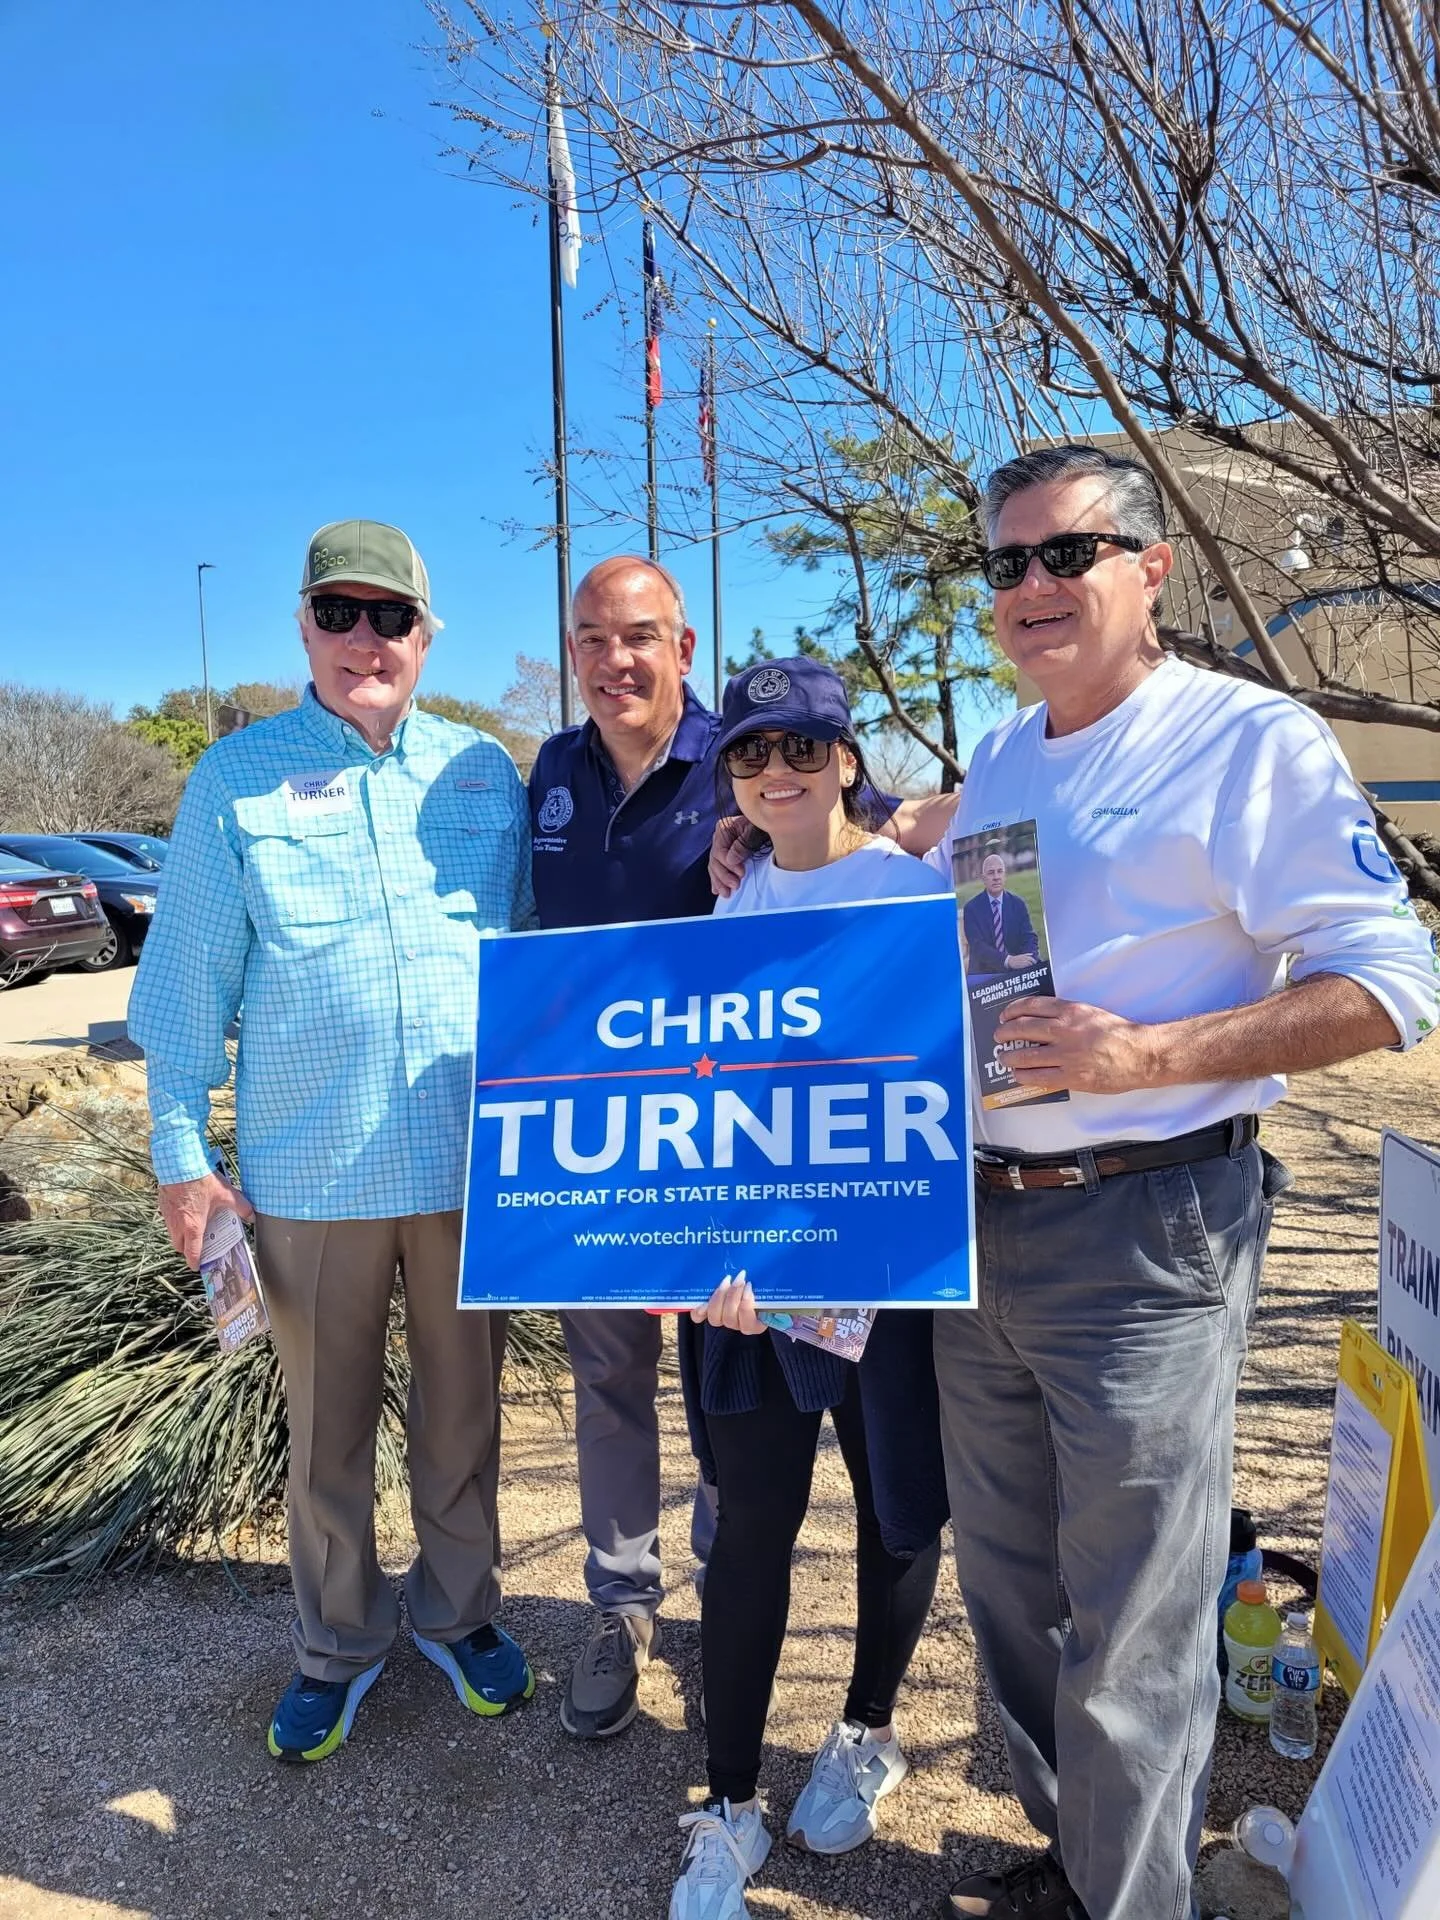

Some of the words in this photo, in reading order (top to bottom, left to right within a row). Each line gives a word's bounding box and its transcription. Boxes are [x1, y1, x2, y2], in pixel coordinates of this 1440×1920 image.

[289, 786, 346, 801] TURNER
[303, 780, 328, 788] CHRIS
[982, 820, 1001, 831] CHRIS
[971, 982, 1004, 1000] LEADING
[1005, 976, 1020, 987] THE
[1021, 967, 1048, 981] FIGHT
[981, 987, 1013, 1005] AGAINST
[1014, 979, 1040, 993] MAGA
[596, 986, 823, 1050] CHRIS
[479, 1080, 959, 1177] TURNER
[496, 1188, 610, 1208] DEMOCRAT
[615, 1187, 658, 1206] FOR
[663, 1184, 729, 1204] STATE
[735, 1179, 931, 1201] REPRESENTATIVE
[573, 1225, 838, 1247] www.votechristurner.com
[1287, 1666, 1306, 1676] Pure
[1289, 1673, 1304, 1683] Life
